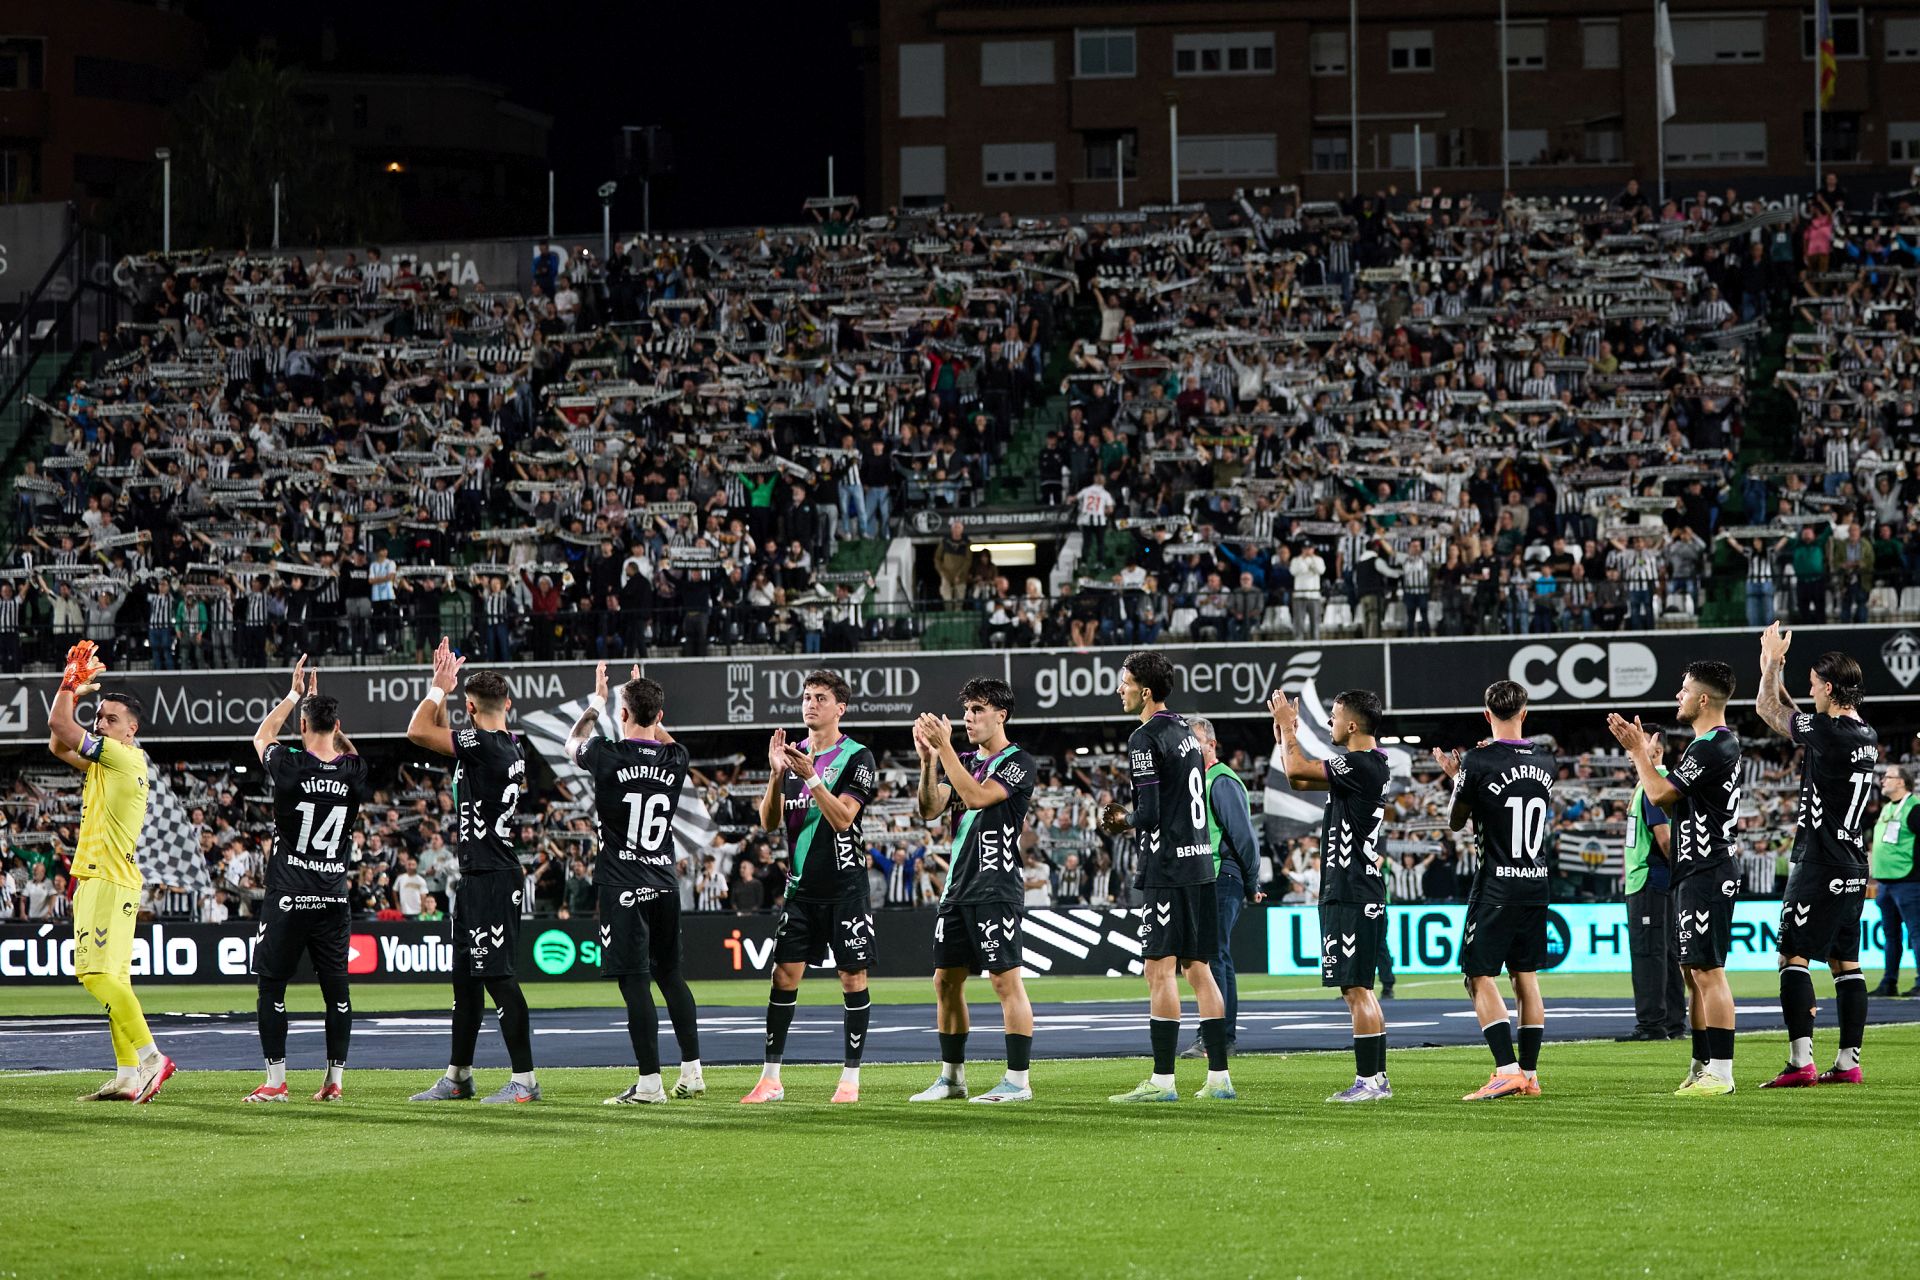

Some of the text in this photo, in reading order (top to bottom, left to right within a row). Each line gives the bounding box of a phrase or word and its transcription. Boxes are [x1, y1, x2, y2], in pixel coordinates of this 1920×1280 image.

[1087, 495, 1101, 512] 21
[1508, 642, 1658, 700] CCD
[769, 704, 778, 714] A
[862, 701, 913, 714] Company
[300, 776, 350, 797] VÍCTOR
[616, 765, 676, 787] MURILLO
[1188, 766, 1206, 830] 8
[295, 801, 348, 859] 14
[460, 801, 470, 842] UAX
[622, 792, 671, 851] 16
[1504, 796, 1547, 860] 10
[980, 830, 998, 872] UAX
[1679, 820, 1693, 862] UAX
[295, 895, 321, 903] COSTA
[295, 902, 326, 911] MÁLAGA
[380, 935, 453, 973] YouTu
[844, 937, 868, 948] MGS
[980, 939, 1000, 950] MGS
